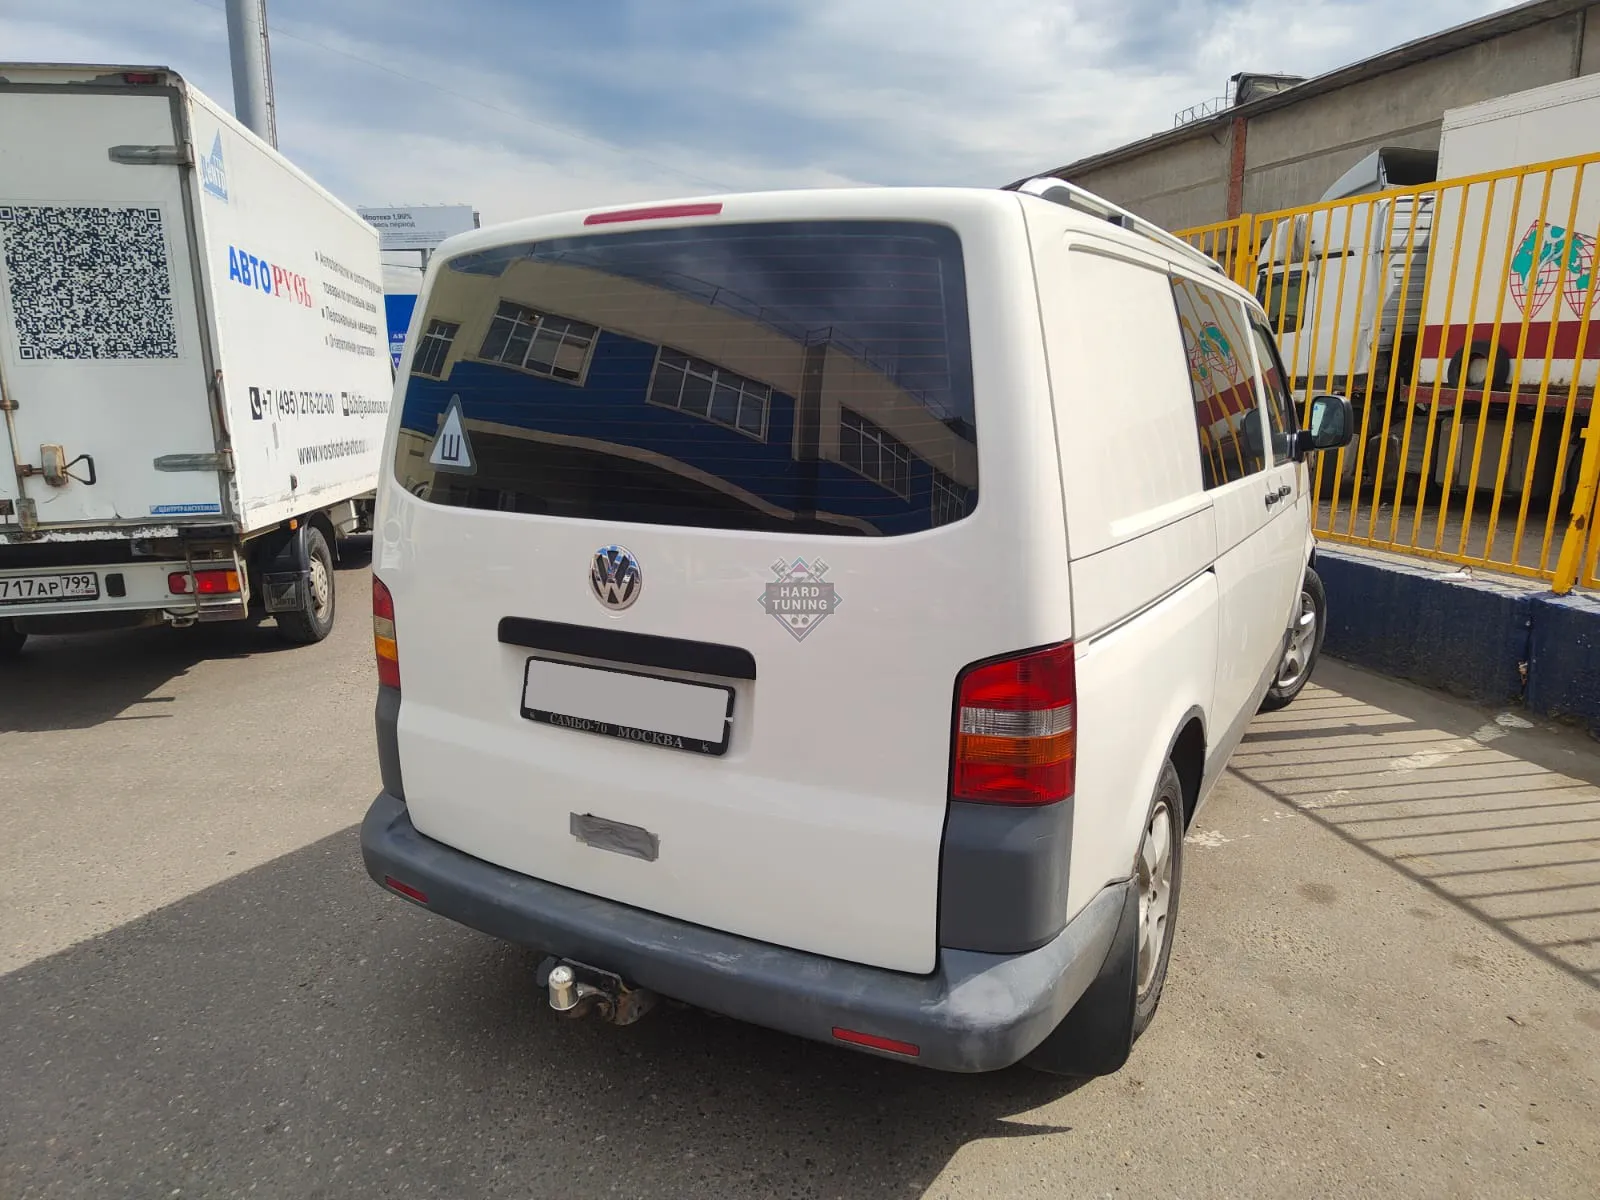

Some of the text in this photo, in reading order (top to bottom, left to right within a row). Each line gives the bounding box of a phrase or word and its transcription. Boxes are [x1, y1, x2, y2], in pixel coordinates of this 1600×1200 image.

[275, 389, 299, 421] (495)
[299, 391, 334, 415] 276-22-00
[441, 433, 461, 461] Ш
[550, 711, 684, 749] САМБО-70 МОСКВА
